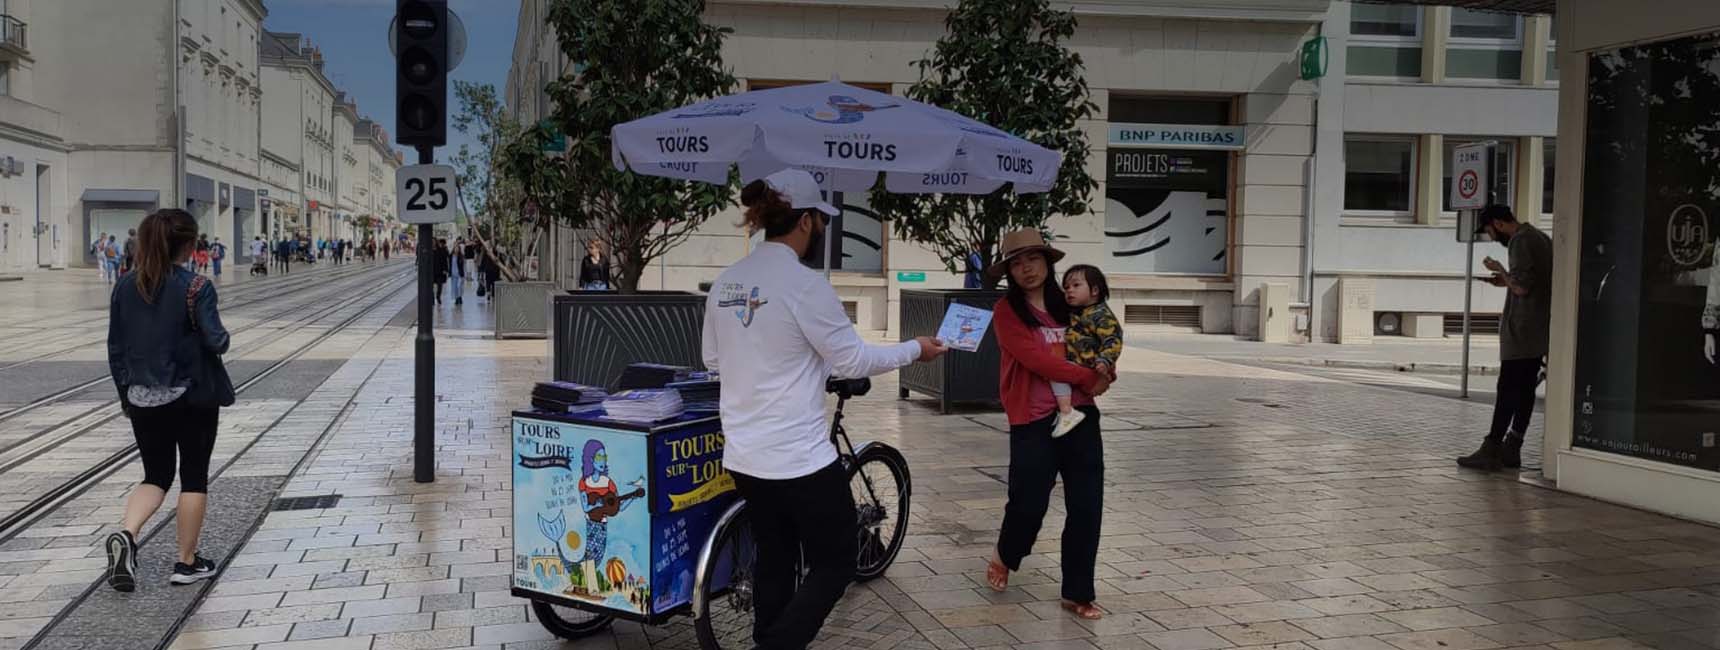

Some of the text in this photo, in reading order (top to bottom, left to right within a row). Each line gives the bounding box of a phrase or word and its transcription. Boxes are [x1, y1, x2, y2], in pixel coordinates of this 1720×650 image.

[656, 135, 709, 152] TOURS
[1120, 130, 1235, 143] BNP PARIBAS
[823, 141, 897, 161] TOURS
[1456, 151, 1480, 162] ZONE
[996, 154, 1033, 175] TOURS
[1115, 153, 1168, 173] PROJETS
[1463, 178, 1474, 191] 30
[404, 177, 449, 211] 25
[519, 422, 561, 439] TOURS
[535, 442, 575, 460] LOIRE
[665, 431, 725, 461] TOURS
[665, 463, 689, 478] SUR
